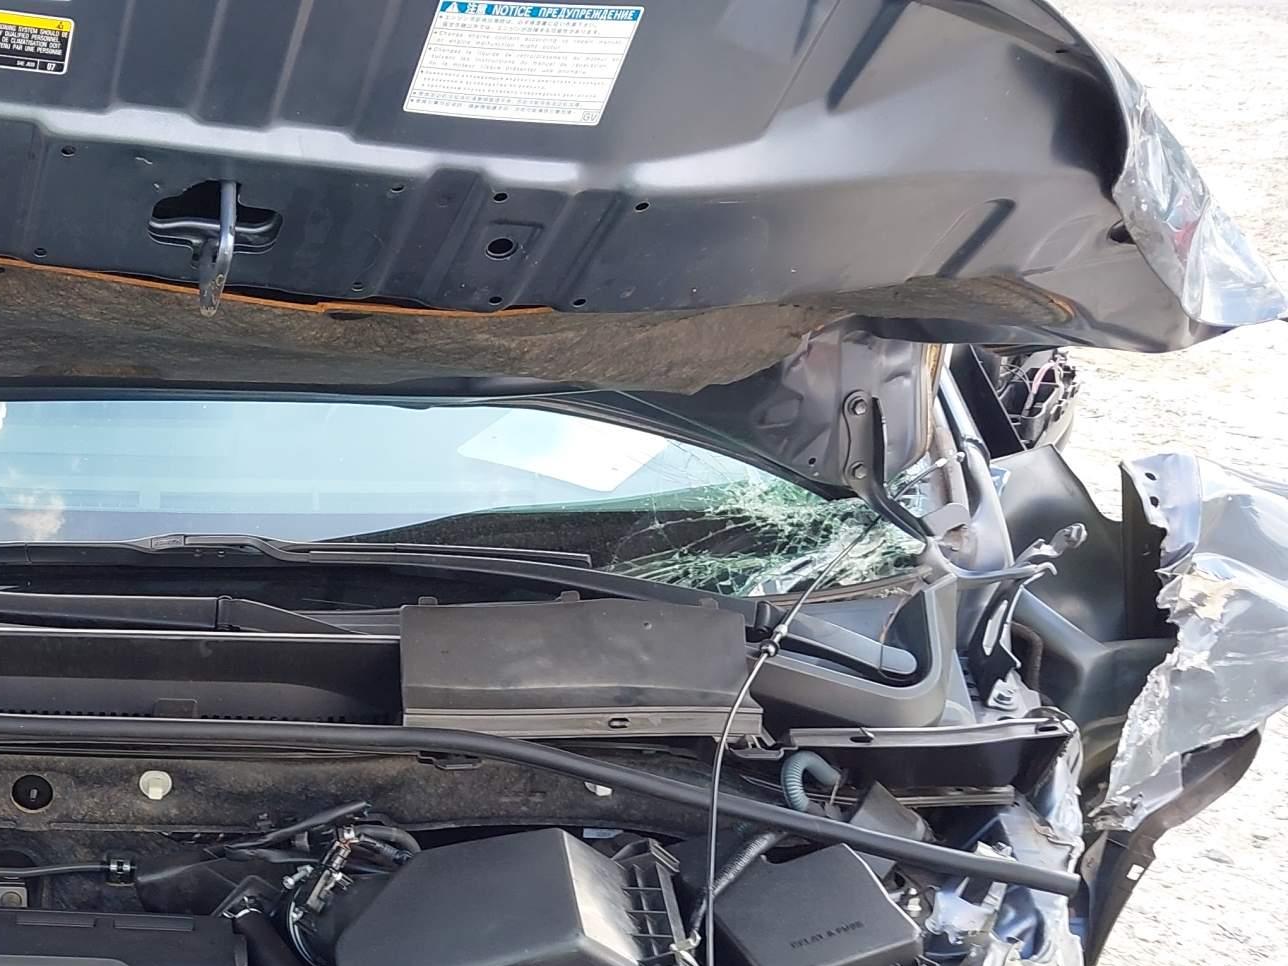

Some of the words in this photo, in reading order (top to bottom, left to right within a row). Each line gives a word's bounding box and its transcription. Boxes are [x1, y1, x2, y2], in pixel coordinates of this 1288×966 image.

[492, 5, 533, 16] NOTICE
[538, 8, 635, 20] ПРЕДУПРЕЖДЕНИЕ
[47, 62, 55, 70] 07
[583, 112, 597, 121] GV
